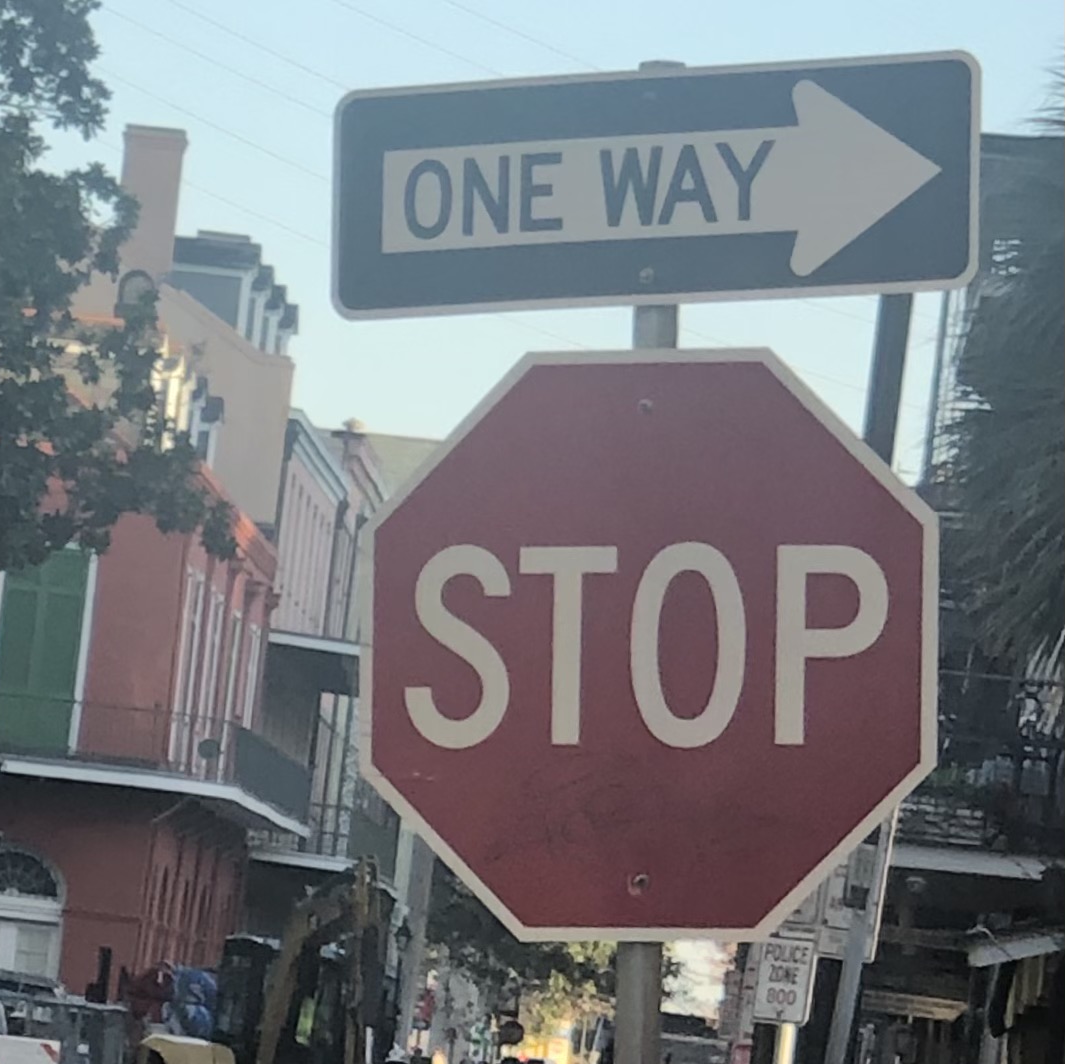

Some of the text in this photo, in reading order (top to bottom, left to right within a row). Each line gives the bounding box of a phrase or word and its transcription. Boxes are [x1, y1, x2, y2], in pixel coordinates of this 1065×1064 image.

[403, 139, 776, 240] ONE WAY
[404, 541, 889, 749] STOP
[764, 943, 809, 965] POLICE
[768, 964, 799, 985] ZONE
[766, 987, 797, 1005] 800
